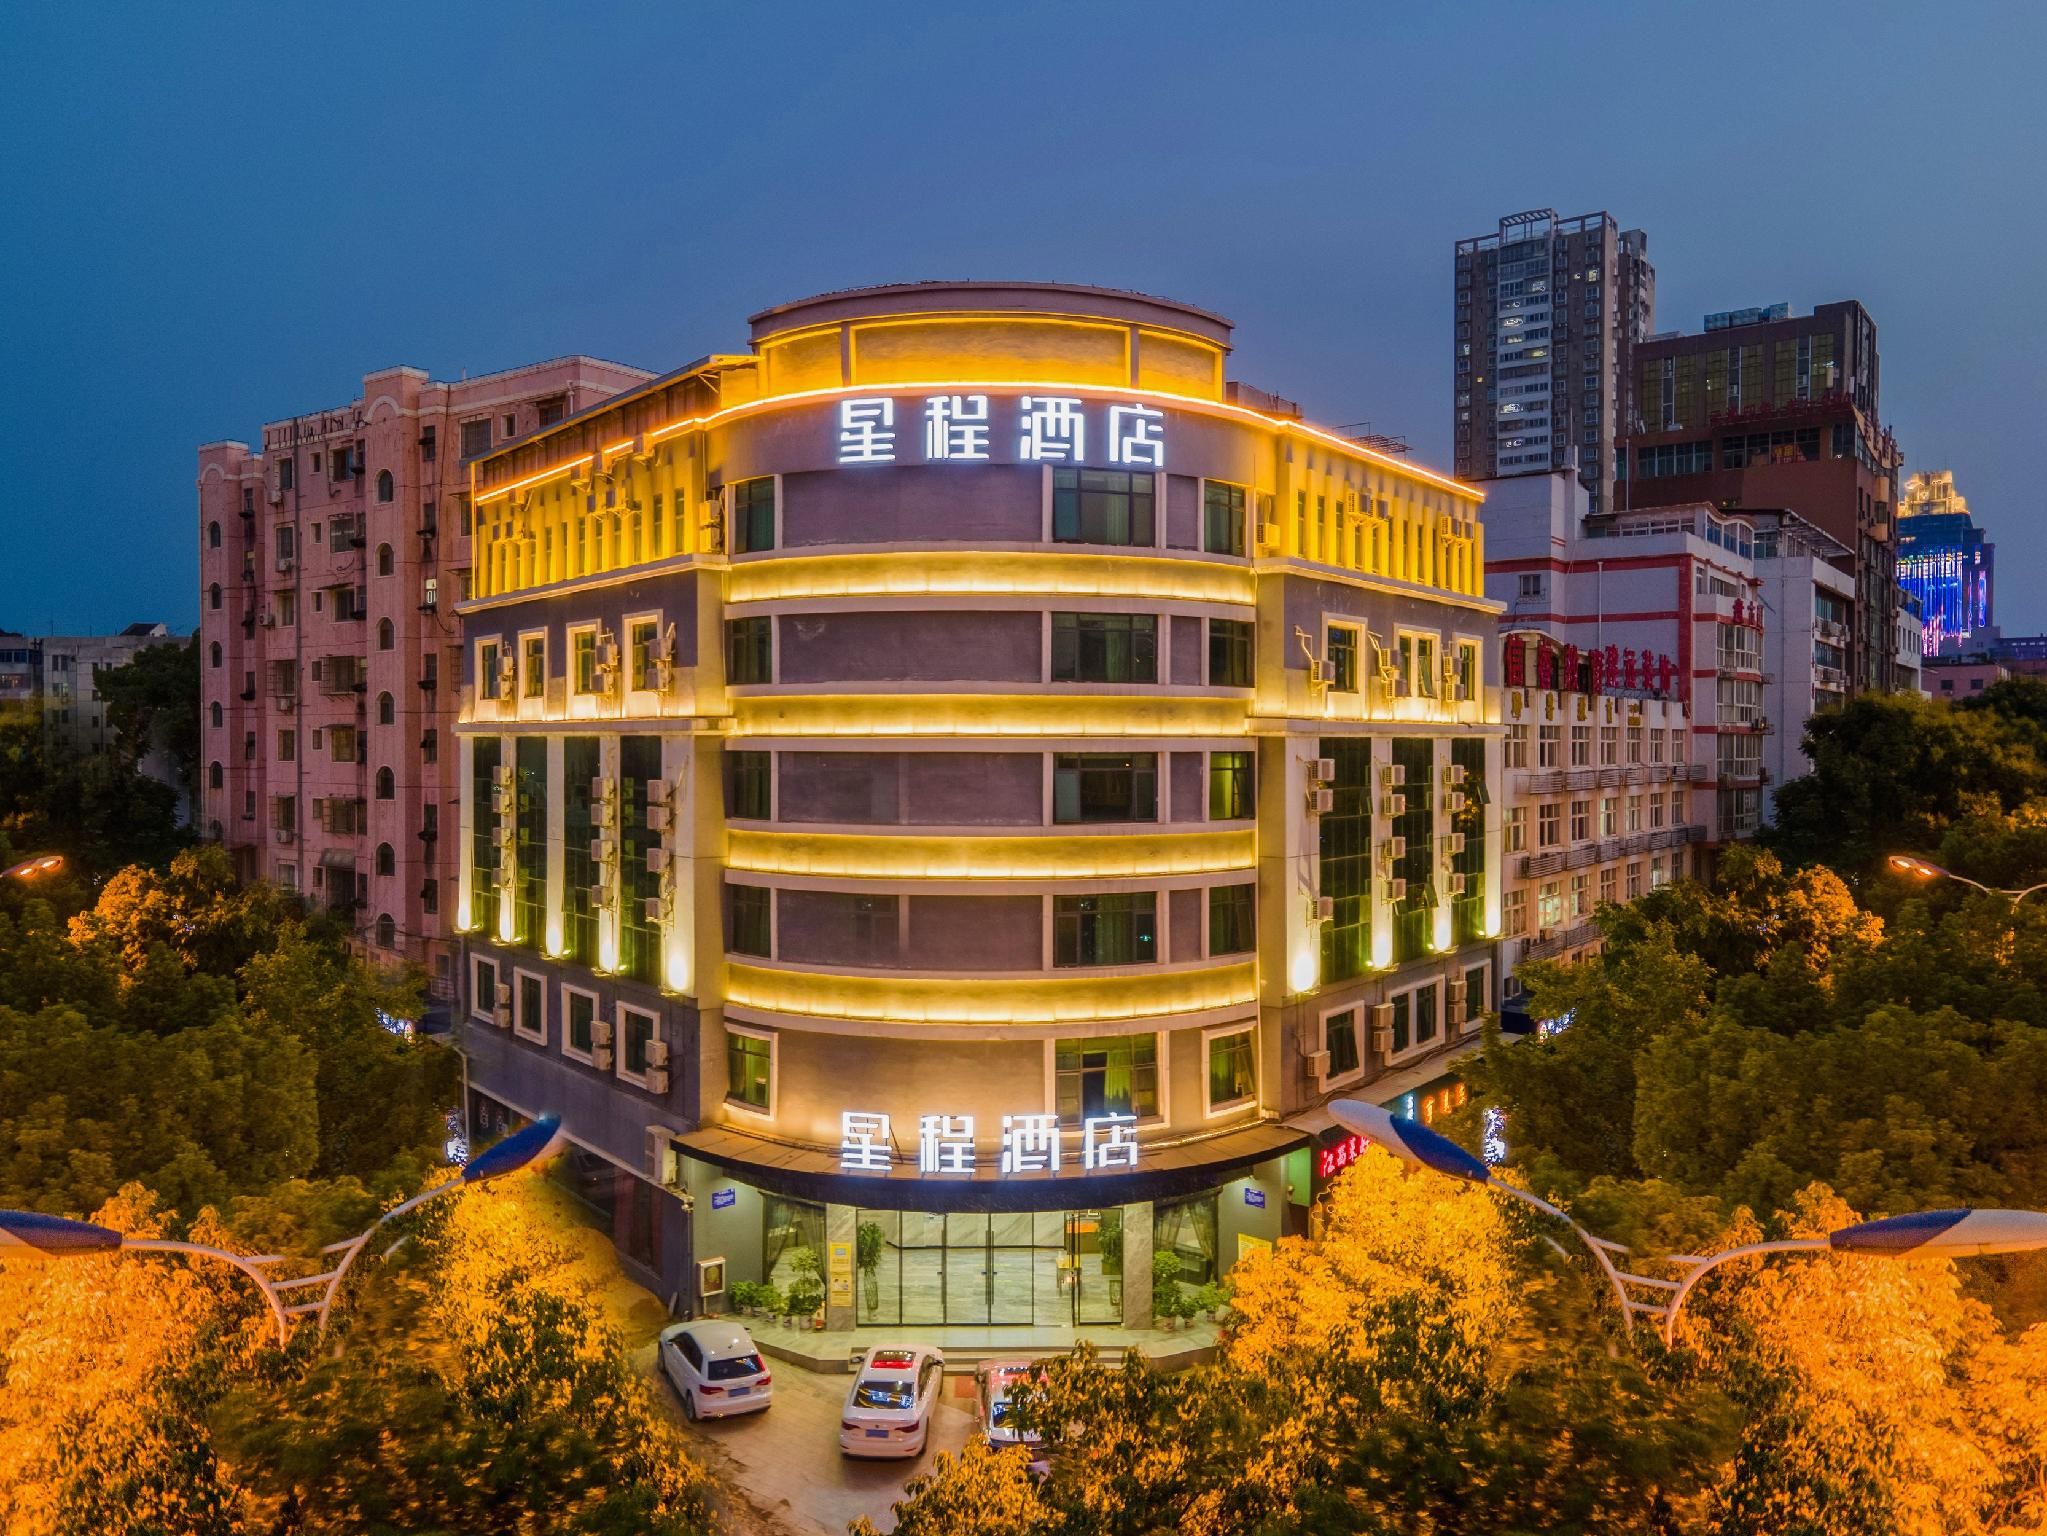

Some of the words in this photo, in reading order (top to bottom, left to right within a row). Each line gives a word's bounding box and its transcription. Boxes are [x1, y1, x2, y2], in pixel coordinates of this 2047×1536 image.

[839, 395, 1164, 467] 星程酒店
[840, 1112, 1138, 1172] 星程酒店
